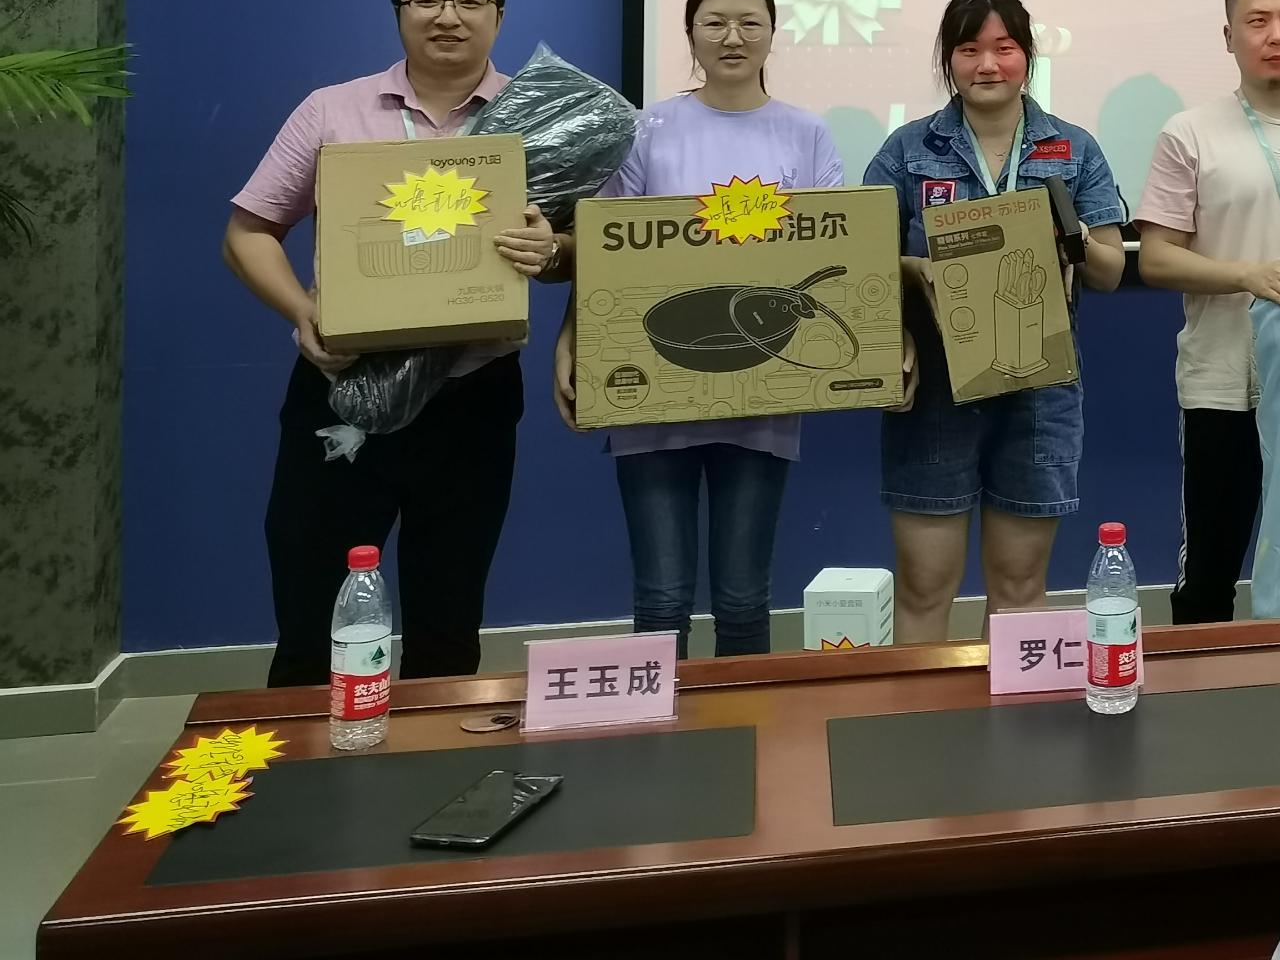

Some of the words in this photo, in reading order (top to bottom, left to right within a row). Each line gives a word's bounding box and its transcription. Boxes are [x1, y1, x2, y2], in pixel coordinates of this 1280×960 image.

[934, 206, 993, 228] SUPOR
[998, 198, 1041, 217] 苏泊尔
[602, 217, 738, 251] SUPO
[1019, 637, 1084, 672] 罗仁
[544, 660, 663, 701] 王玉成
